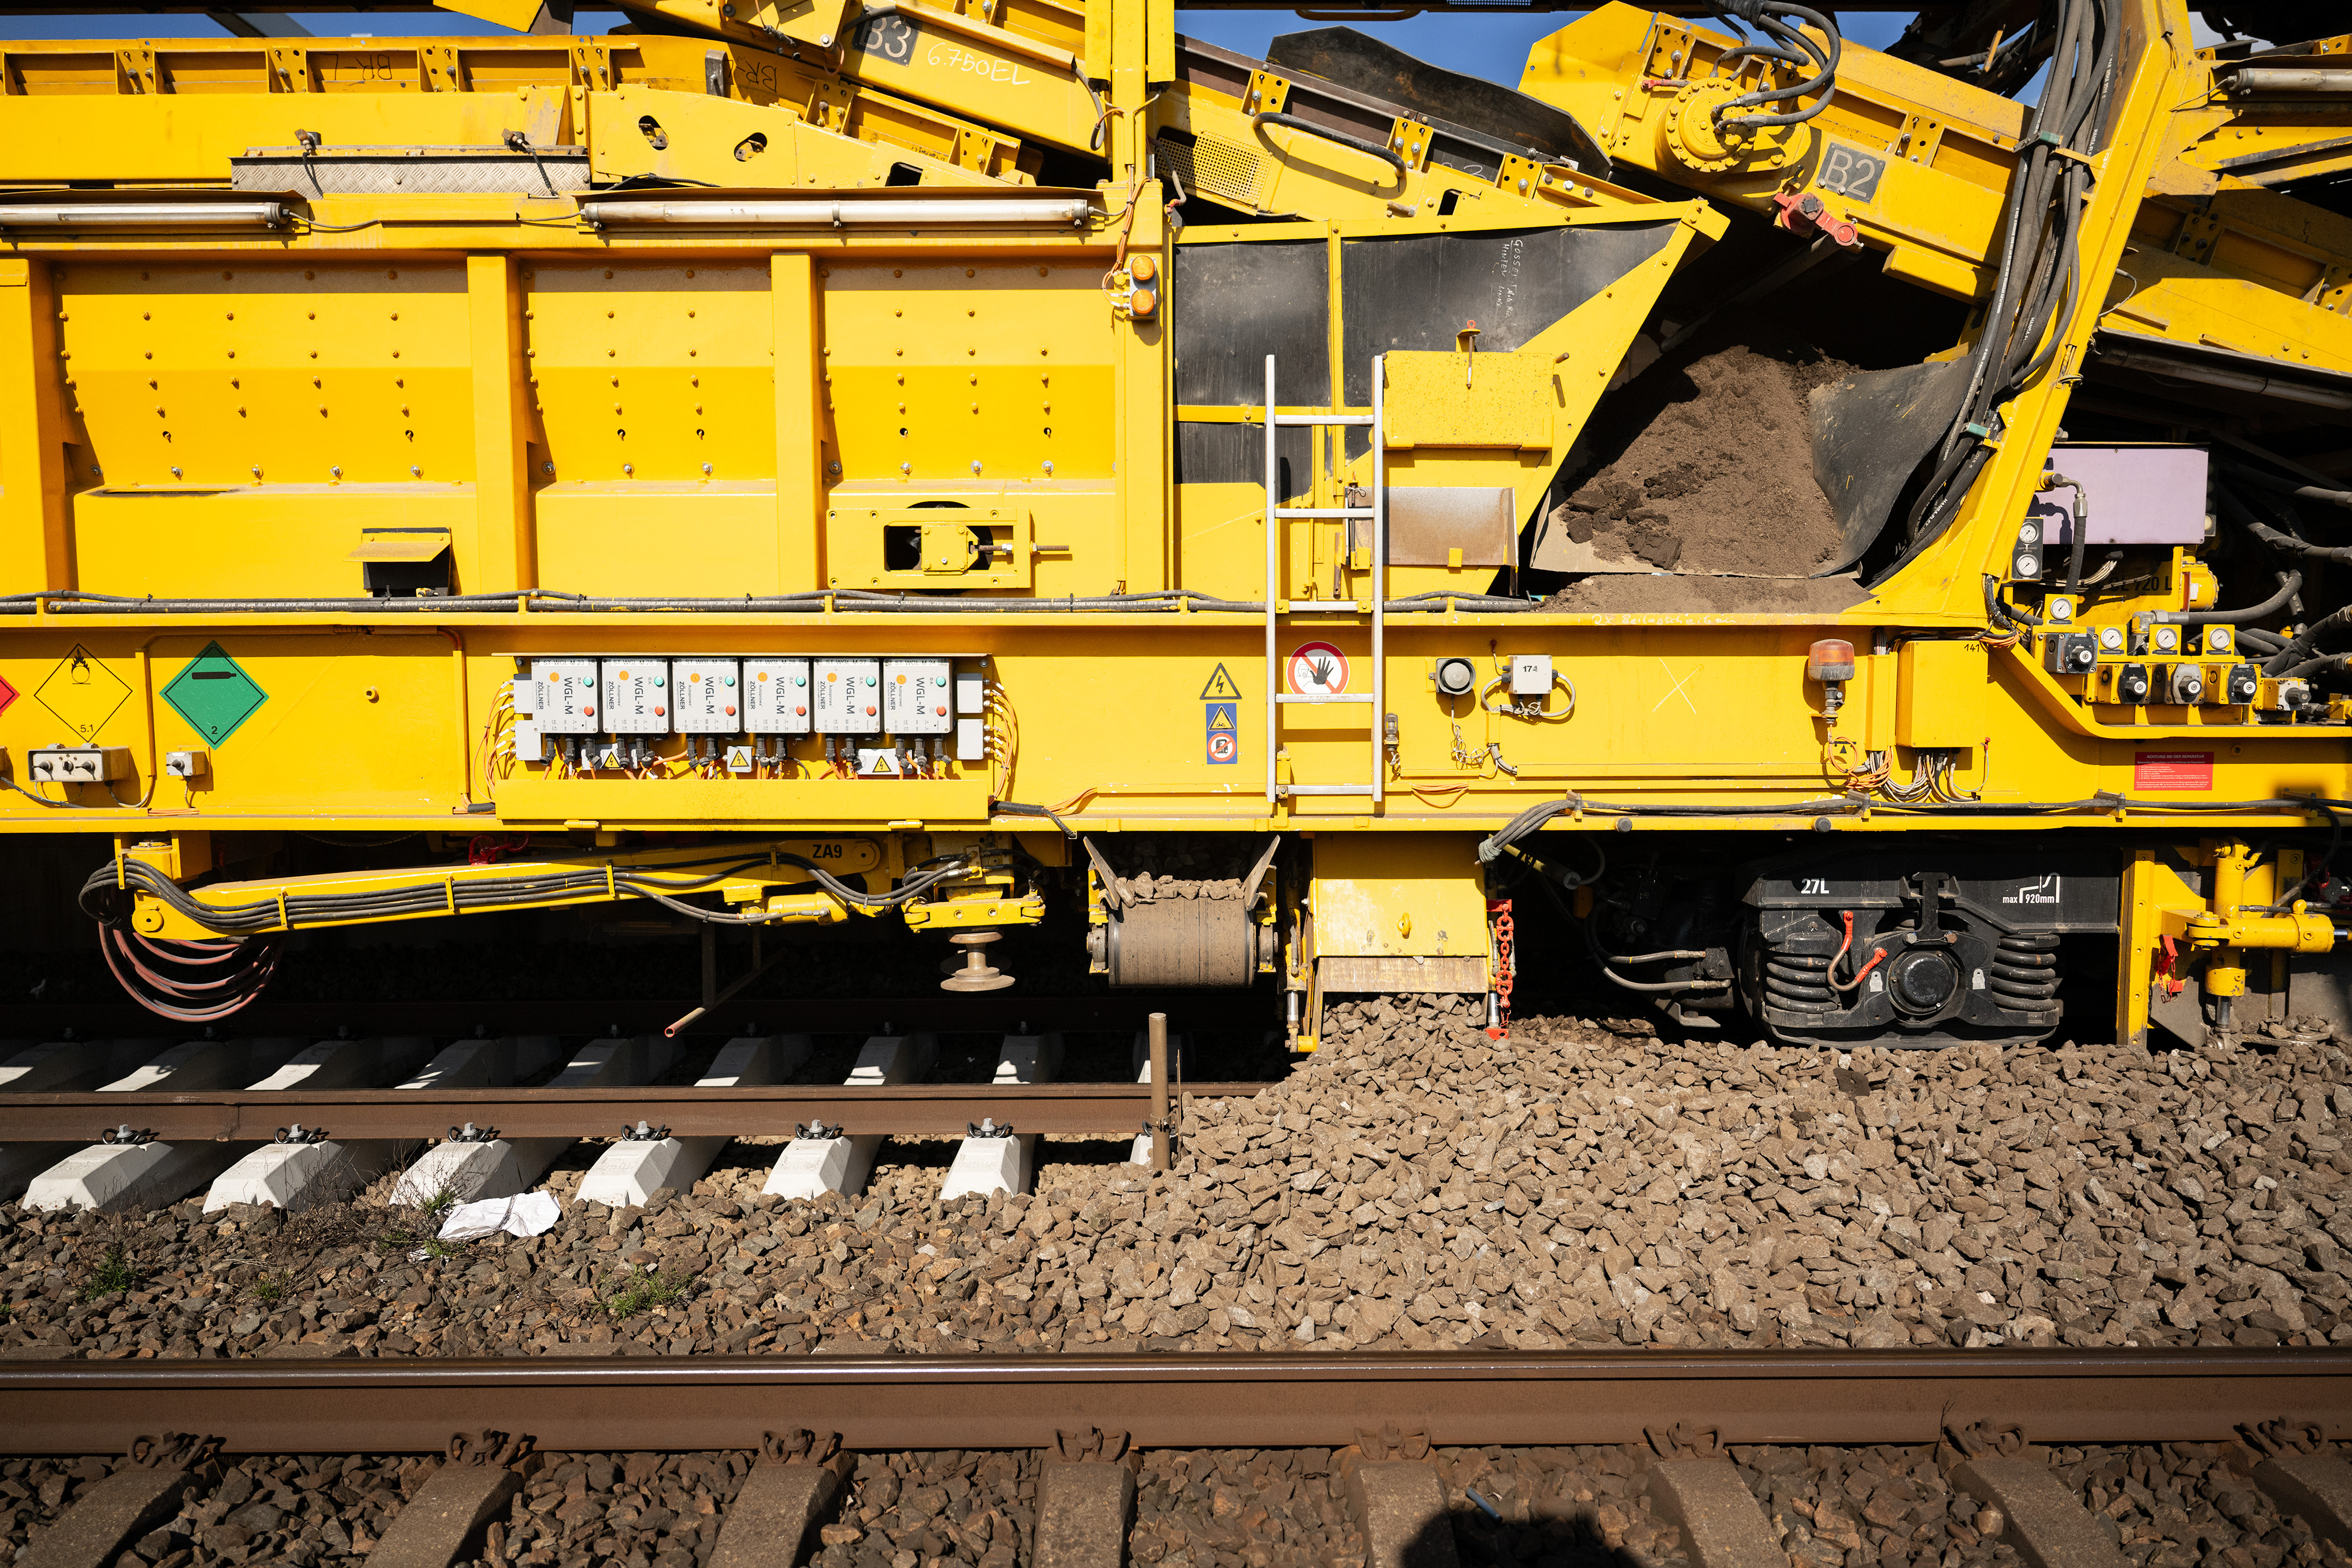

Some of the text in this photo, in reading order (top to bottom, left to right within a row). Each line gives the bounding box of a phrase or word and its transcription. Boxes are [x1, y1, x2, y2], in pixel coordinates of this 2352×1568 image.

[859, 15, 912, 58] B3
[1824, 149, 1875, 197] B2
[1941, 439, 1954, 461] HANSA-FLEX
[1924, 497, 1948, 528] HANSA-FLEX
[2165, 576, 2173, 590] L
[1964, 643, 1979, 652] 141
[564, 677, 573, 714] WGL-M
[635, 677, 643, 714] WGL-M
[705, 677, 714, 714] WGL-M
[80, 724, 94, 733] 5.1
[211, 726, 218, 734] 2
[812, 844, 842, 858] ZA9
[1800, 878, 1830, 894] 27L
[2025, 894, 2055, 904] 920mm
